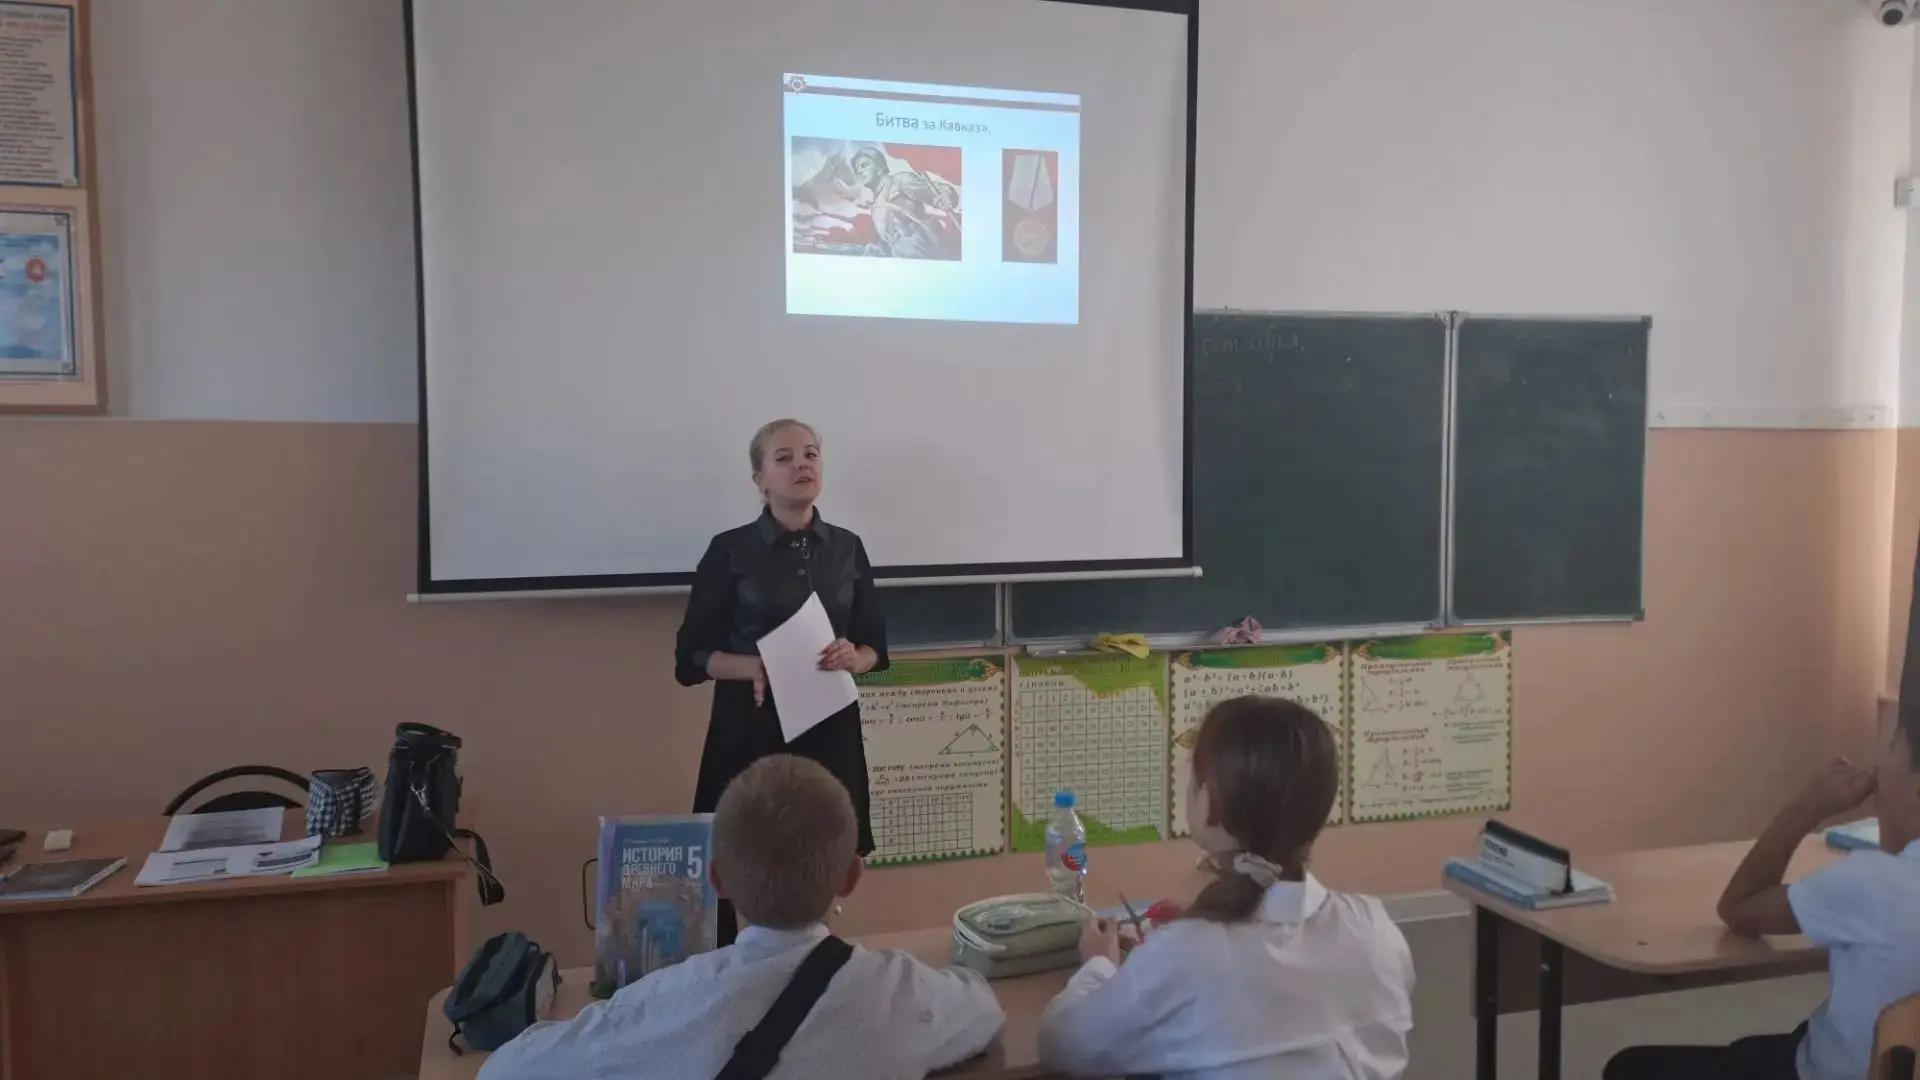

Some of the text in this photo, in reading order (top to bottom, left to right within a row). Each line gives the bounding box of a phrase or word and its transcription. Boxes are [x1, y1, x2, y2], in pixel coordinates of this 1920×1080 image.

[876, 112, 919, 130] Битва
[922, 119, 936, 130] за
[622, 846, 683, 863] ИСТОРИЯ
[687, 846, 702, 879] 5
[621, 876, 654, 890] МИРА
